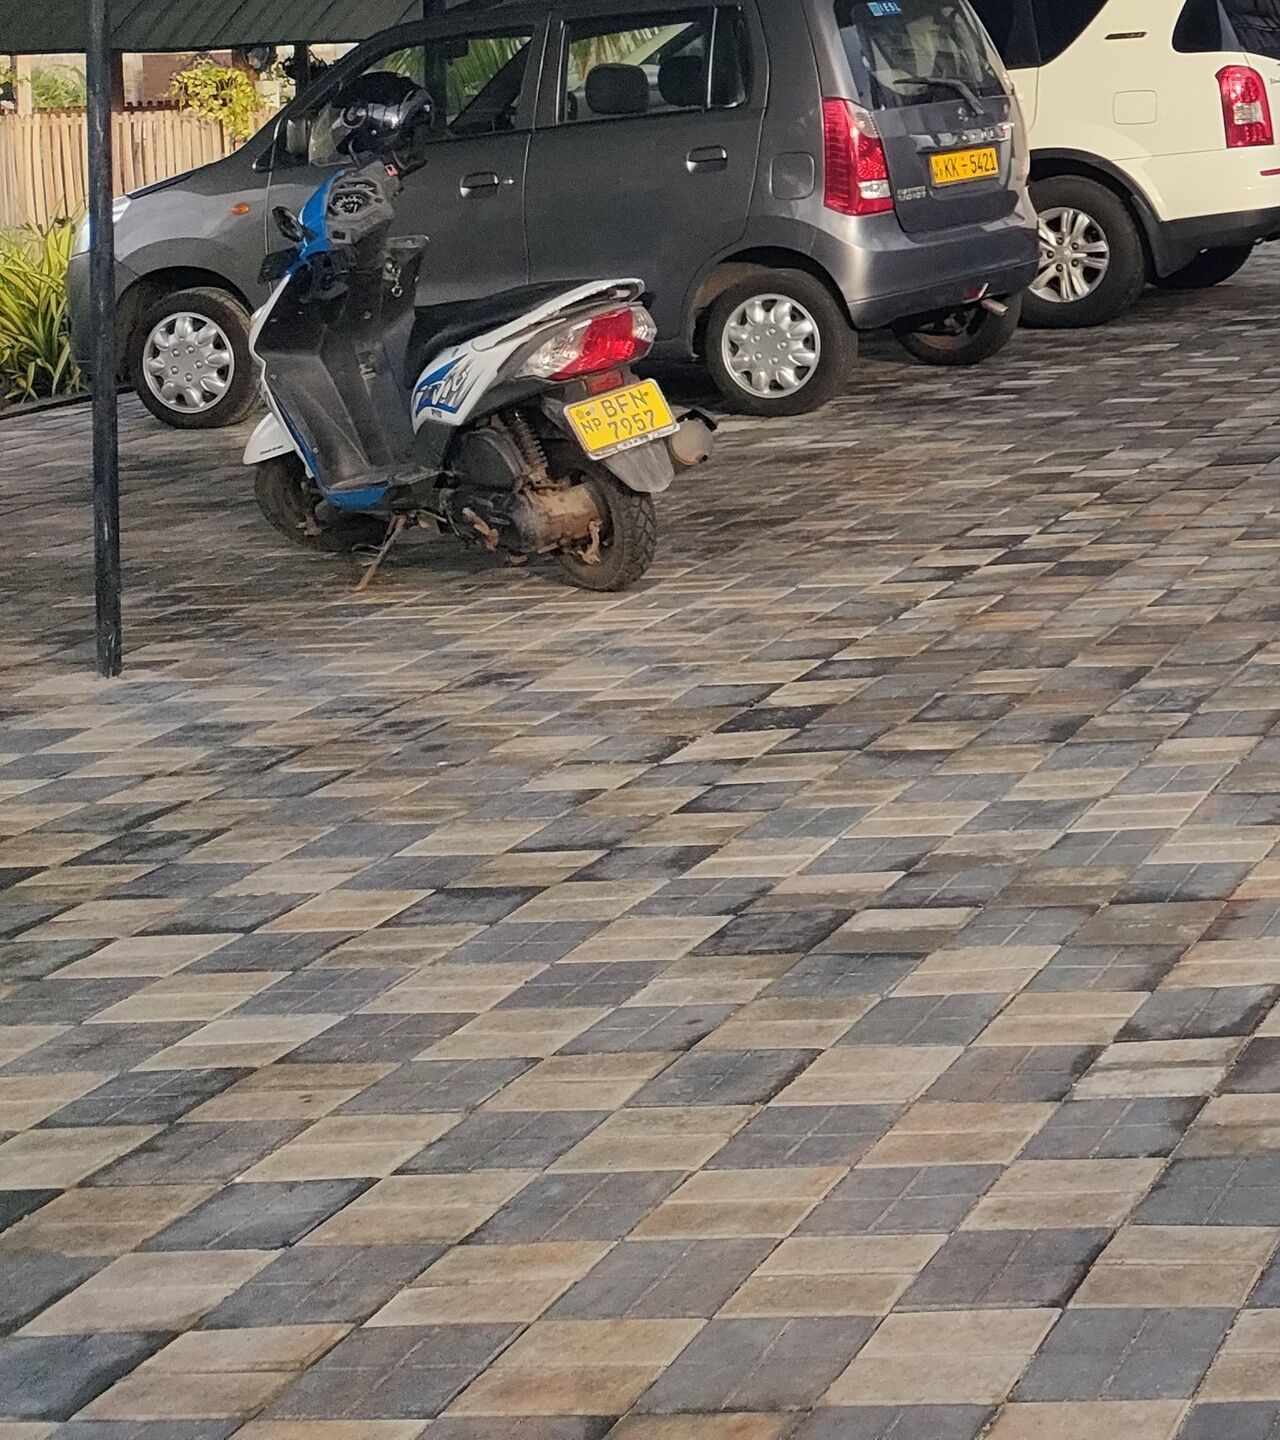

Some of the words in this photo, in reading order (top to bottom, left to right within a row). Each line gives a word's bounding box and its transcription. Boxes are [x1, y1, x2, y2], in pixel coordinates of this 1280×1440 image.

[600, 389, 648, 418] BFN
[581, 417, 601, 434] NP
[607, 409, 656, 440] 7957
